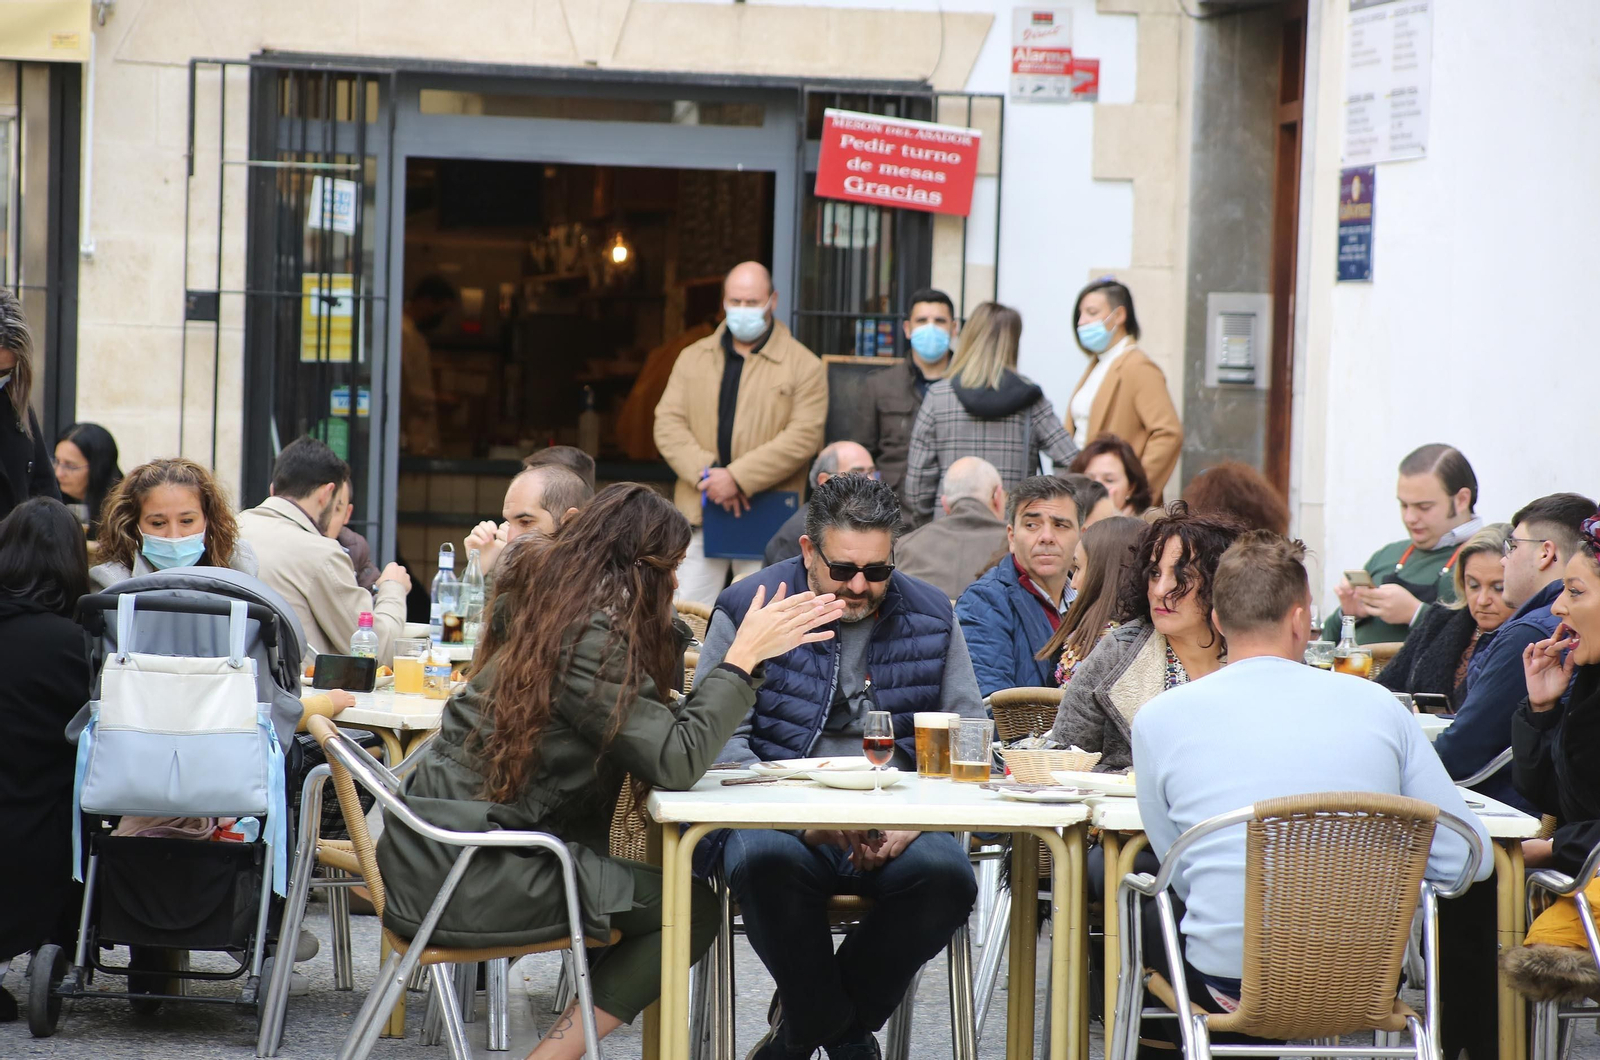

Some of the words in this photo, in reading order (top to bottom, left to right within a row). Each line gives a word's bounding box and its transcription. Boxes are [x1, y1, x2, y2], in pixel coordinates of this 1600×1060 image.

[839, 133, 896, 155] Pedir
[901, 144, 962, 164] turno
[846, 157, 873, 173] de
[878, 162, 947, 183] mesas
[843, 176, 943, 205] Gracias
